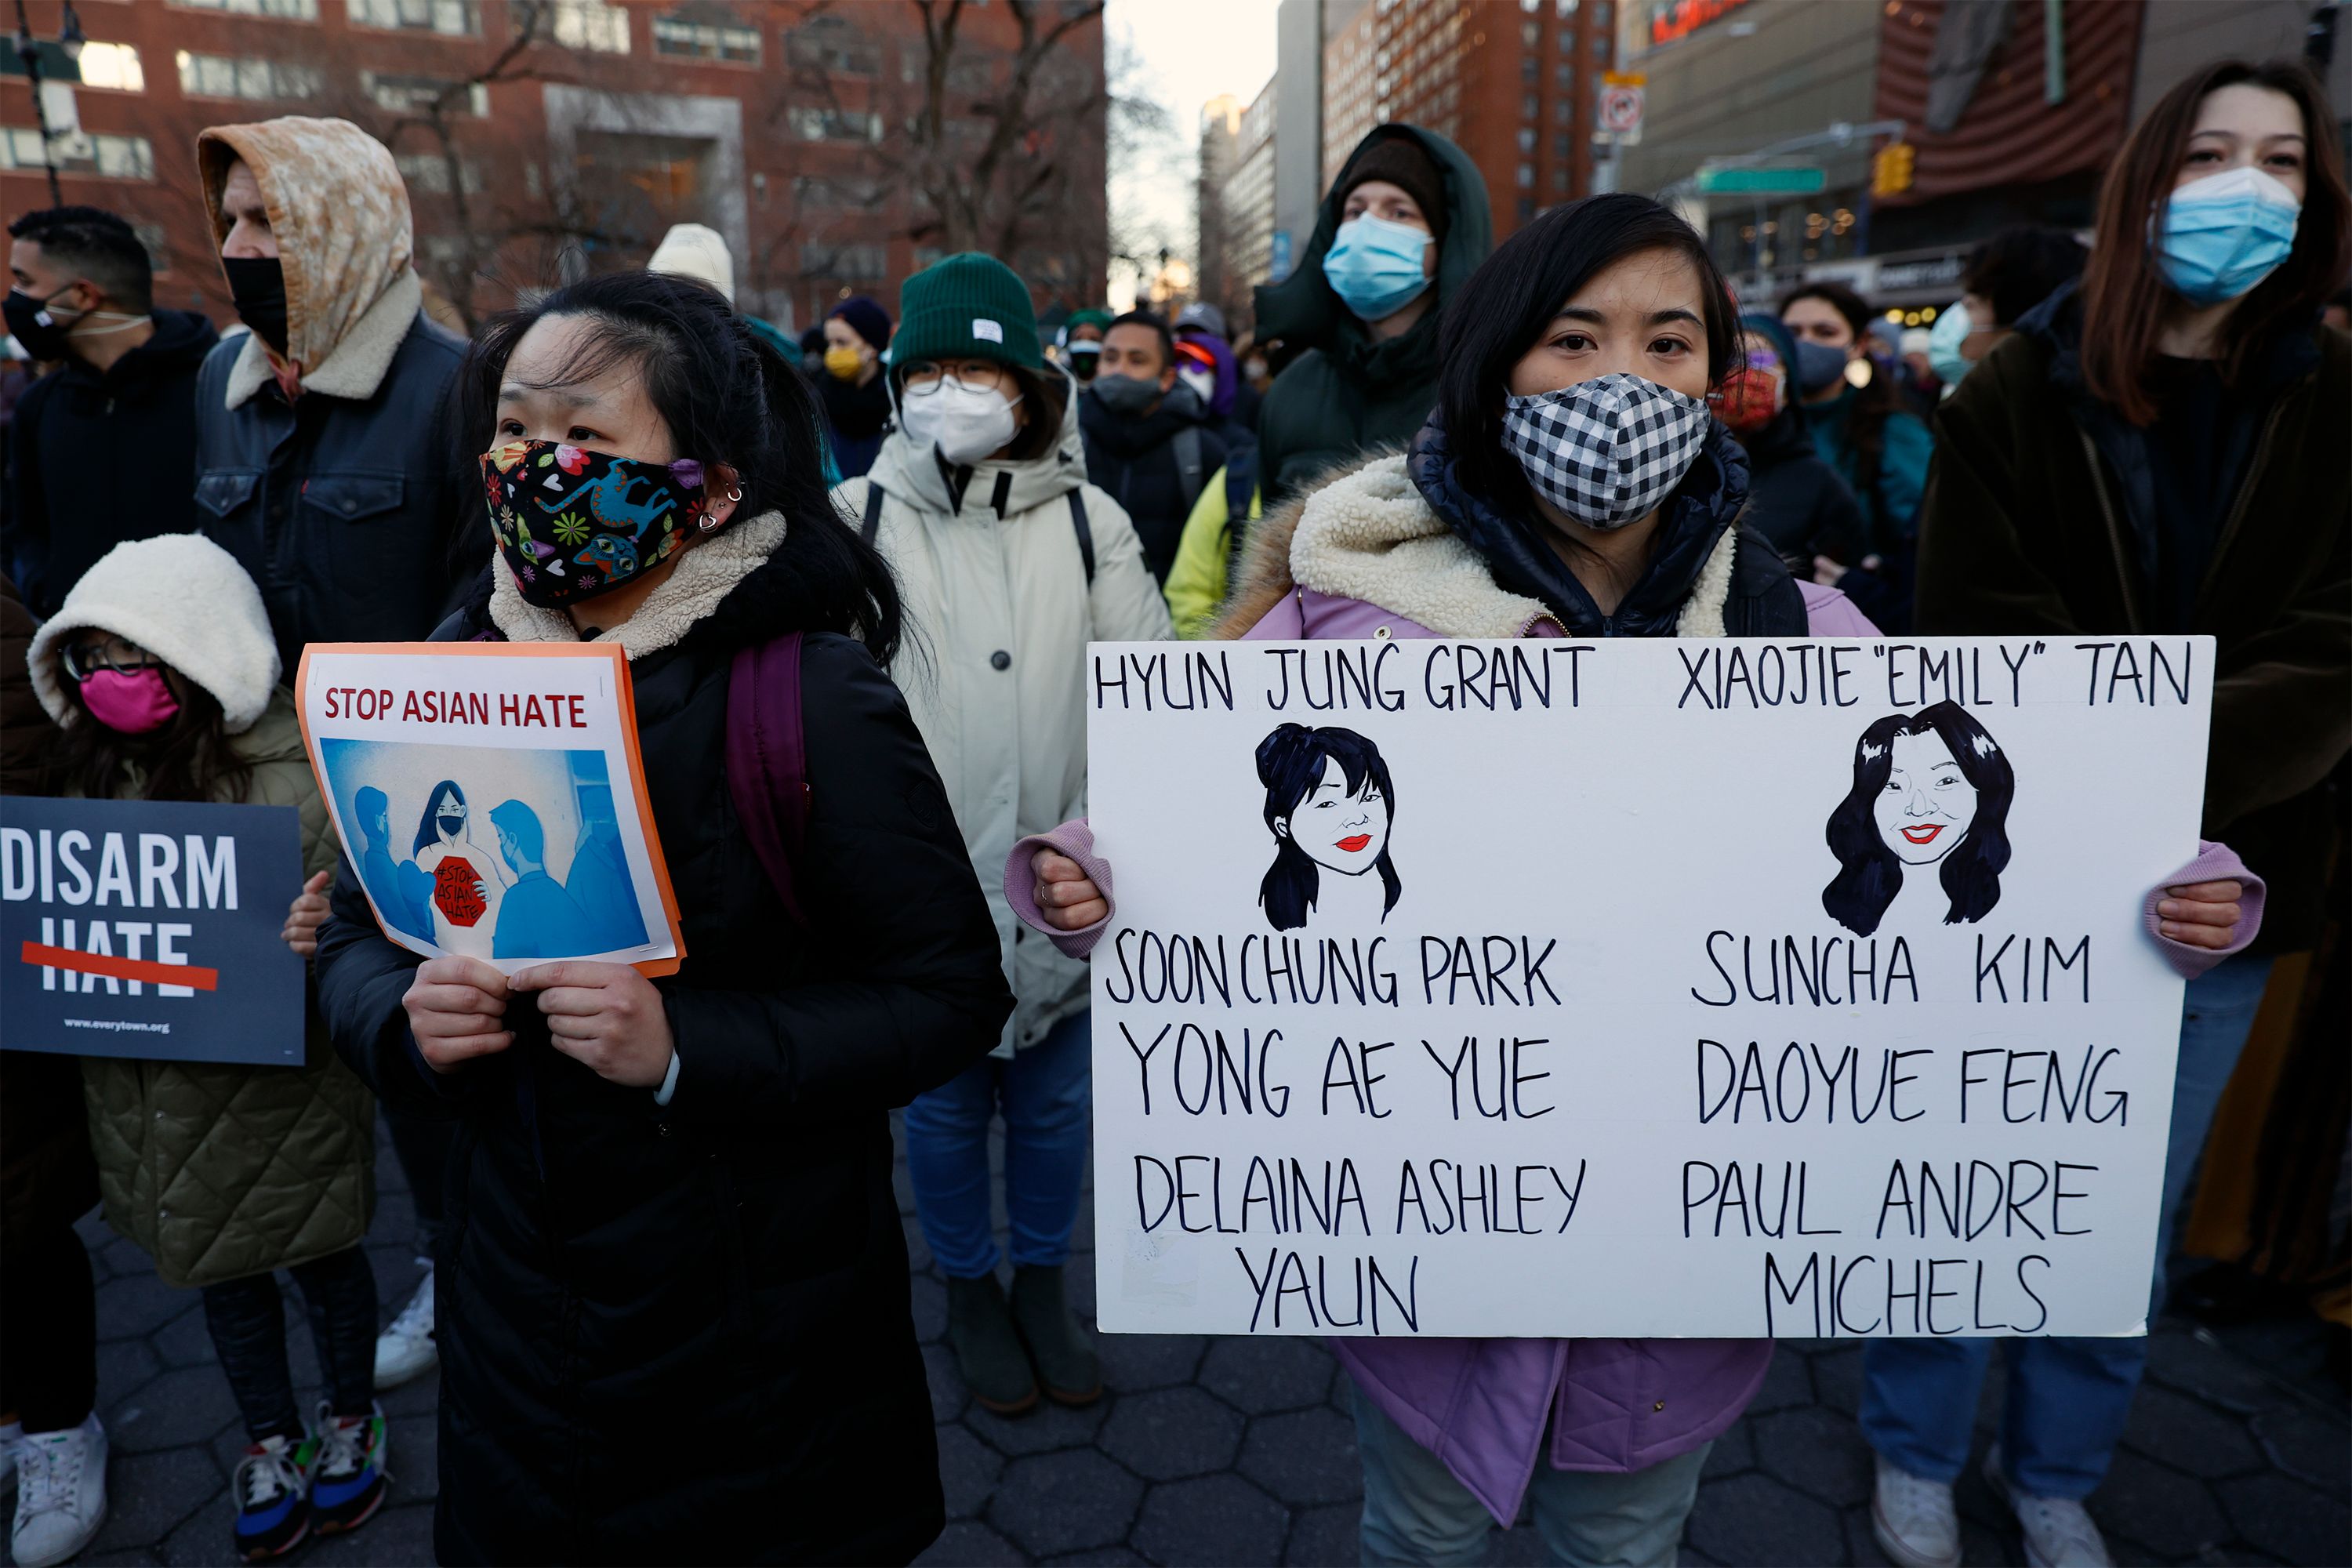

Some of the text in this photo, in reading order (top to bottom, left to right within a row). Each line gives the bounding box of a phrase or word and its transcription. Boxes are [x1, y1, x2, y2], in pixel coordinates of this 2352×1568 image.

[325, 688, 587, 728] STOP ASIAN HATE
[1096, 643, 1595, 712] HYUN JUNG GRANT
[1678, 641, 2190, 710] XIAOJIE "EMILY" TAN
[1, 827, 238, 910] DISARM
[437, 884, 474, 903] ASIAN
[445, 902, 479, 919] HATE
[42, 917, 194, 997] HATE
[1421, 935, 1561, 1006] PARK
[1691, 929, 2090, 1007] SUNCHA KIM
[64, 1018, 170, 1035] www.everytown.org
[1119, 1022, 1555, 1122] YONG AE YUE
[1697, 1038, 2129, 1127] DAOYUE FENG
[1134, 1156, 1586, 1236] DELAINA ASHLEY
[1682, 1158, 2100, 1243] PAUL ANDRE
[1235, 1247, 1419, 1336] YAUN
[1765, 1251, 2051, 1338] MICHELS
